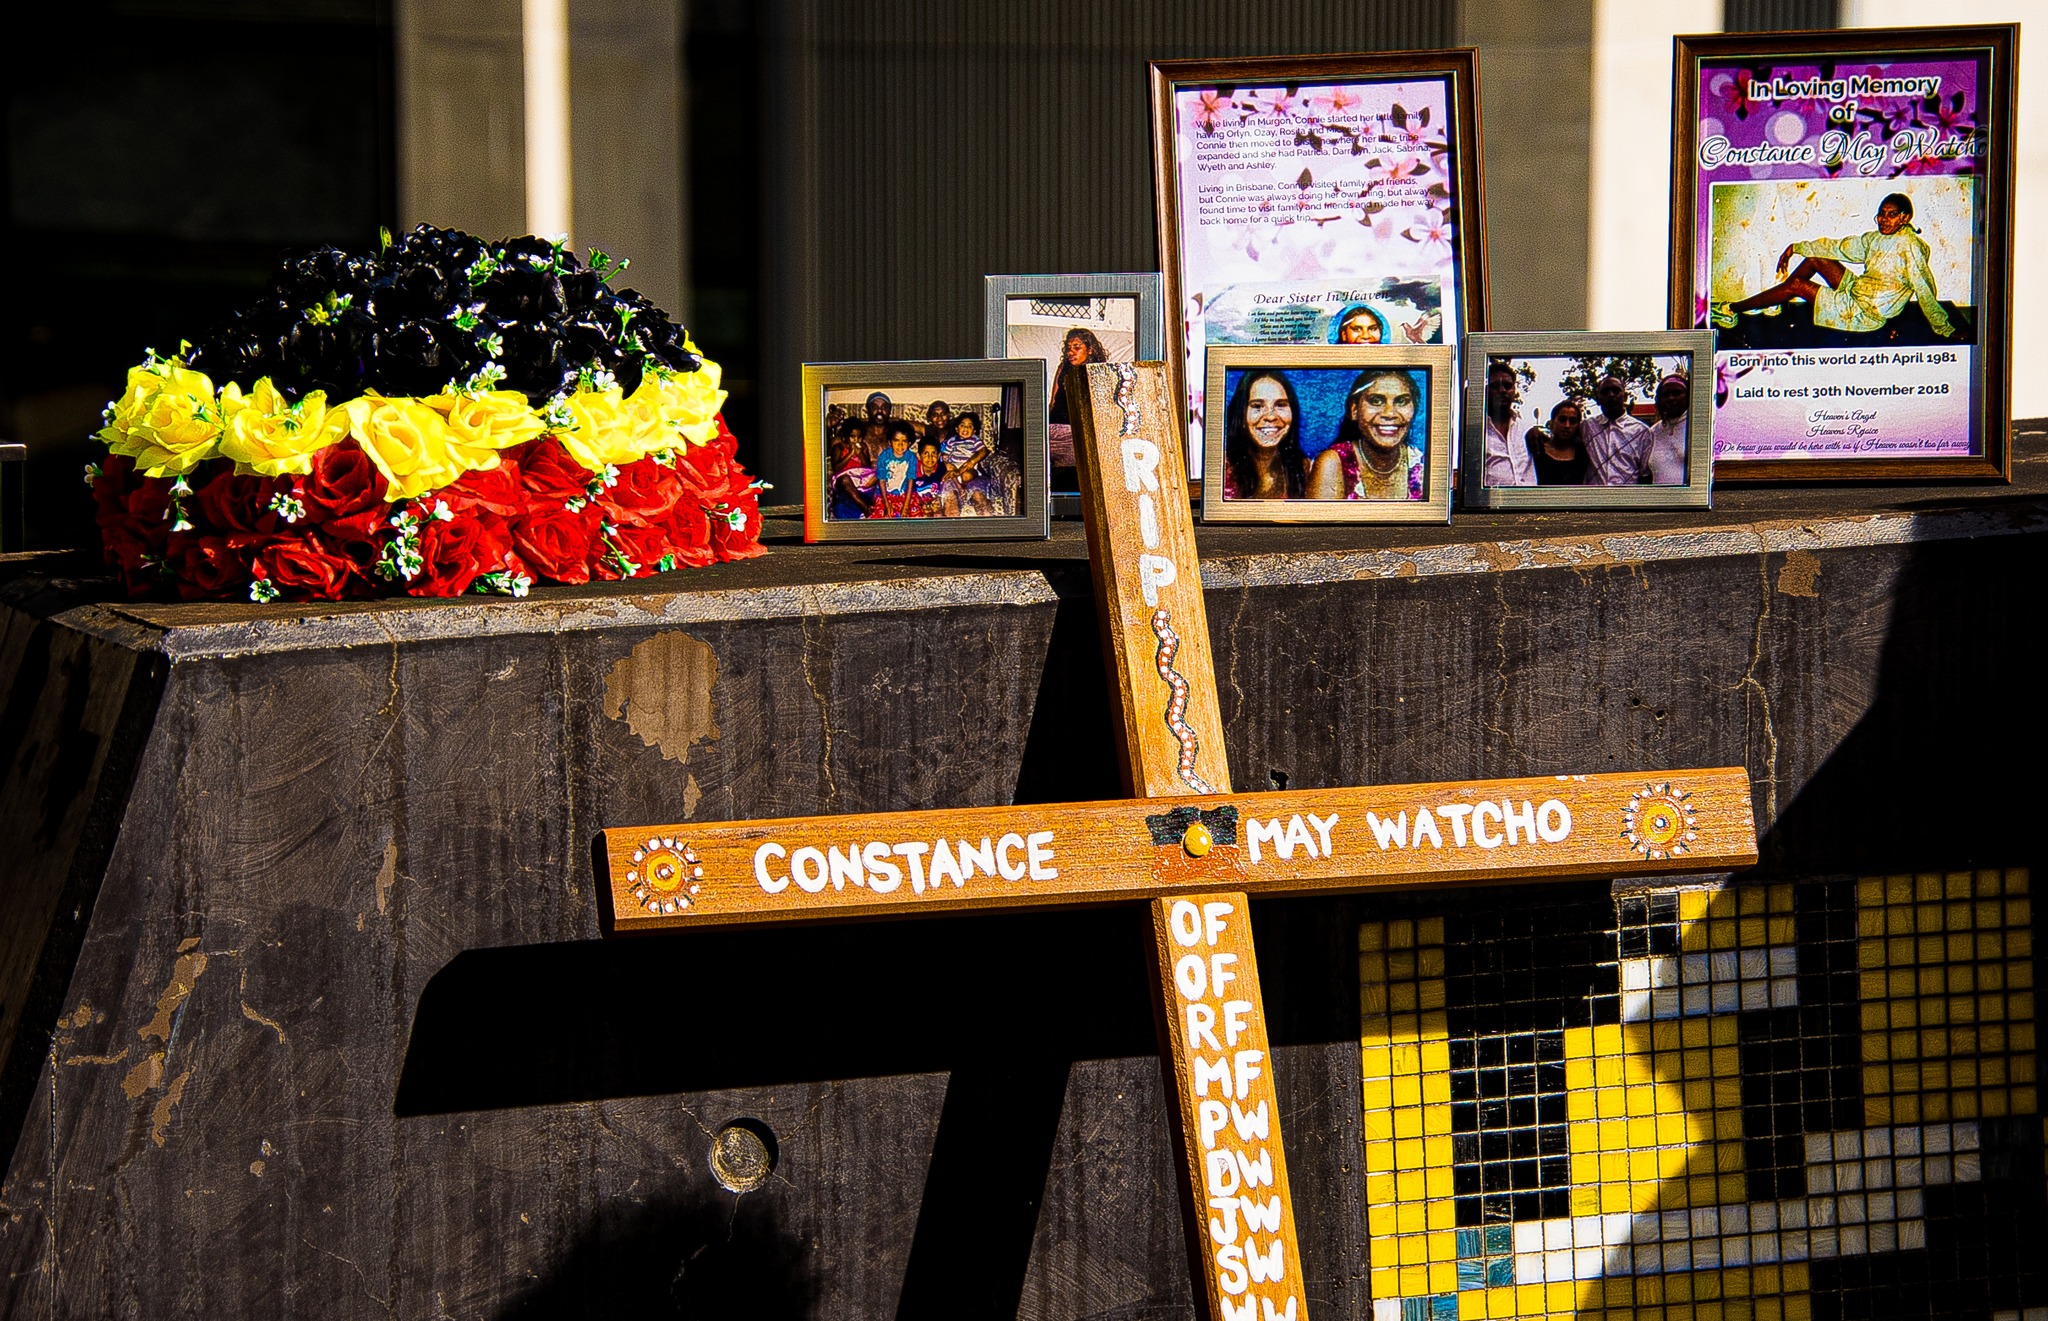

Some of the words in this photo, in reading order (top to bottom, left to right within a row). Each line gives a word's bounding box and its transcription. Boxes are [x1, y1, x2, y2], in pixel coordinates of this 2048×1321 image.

[1751, 80, 1768, 98] In
[1776, 79, 1844, 98] Loving
[1851, 76, 1938, 97] Memory
[1832, 103, 1854, 121] of
[1222, 118, 1246, 128] living
[1248, 118, 1256, 126] in
[1295, 115, 1326, 124] Connie
[1327, 113, 1358, 122] started
[1360, 113, 1374, 122] her
[1196, 131, 1225, 140] having
[1280, 127, 1306, 136] Rosita
[1307, 126, 1325, 135] and
[1196, 141, 1227, 150] Connie
[1229, 139, 1249, 148] then
[1250, 138, 1281, 148] moved
[1282, 139, 1292, 147] to
[1362, 135, 1376, 144] her
[1399, 132, 1419, 142] tribe
[1197, 151, 1240, 161] expanded
[1242, 150, 1259, 159] and
[1260, 149, 1277, 158] she
[1278, 149, 1295, 157] had
[1700, 136, 1813, 167] Constance
[1821, 131, 1886, 174] May
[1197, 163, 1226, 173] Wyeth
[1228, 162, 1245, 170] and
[1198, 185, 1224, 194] Living
[1226, 184, 1234, 192] in
[1277, 180, 1308, 190] Connie
[1309, 180, 1338, 189] visited
[1339, 178, 1366, 188] family
[1367, 178, 1384, 187] and
[1199, 195, 1214, 204] but
[1215, 195, 1246, 203] Connie
[1266, 193, 1297, 203] always
[1298, 192, 1323, 201] doing
[1325, 191, 1339, 199] her
[1340, 191, 1360, 199] own
[1387, 188, 1403, 197] but
[1199, 206, 1225, 214] found
[1226, 205, 1246, 214] time
[1248, 205, 1257, 213] to
[1258, 204, 1275, 212] visit
[1277, 203, 1303, 213] family
[1304, 201, 1322, 210] and
[1324, 200, 1355, 210] friends
[1355, 200, 1372, 209] and
[1401, 198, 1415, 207] her
[1417, 199, 1435, 208] way
[1200, 216, 1221, 225] back
[1223, 215, 1248, 224] home
[1250, 215, 1262, 224] for
[1271, 214, 1294, 225] quick
[1253, 293, 1285, 304] Dear
[1286, 291, 1322, 304] Sister
[1326, 291, 1340, 302] In
[1341, 289, 1390, 302] Heaven
[1729, 355, 1761, 367] Born
[1763, 354, 1789, 367] into
[1791, 353, 1816, 366] this
[1818, 353, 1856, 365] world
[1859, 352, 1889, 367] 24th
[1891, 352, 1924, 367] April
[1926, 352, 1958, 365] 1981
[1736, 386, 1764, 399] Laid
[1767, 387, 1781, 398] to
[1784, 387, 1809, 398] rest
[1812, 385, 1842, 400] 30th
[1845, 384, 1915, 397] November
[1917, 383, 1950, 396] 2018
[1808, 410, 1850, 423] Heaven's
[1851, 409, 1877, 423] Angel
[1806, 425, 1845, 437] Heavens
[1847, 424, 1879, 438] Rejoice
[1714, 440, 1735, 453] We
[1736, 442, 1756, 451] know
[1756, 444, 1773, 454] you
[1774, 441, 1798, 451] would
[1799, 441, 1808, 451] be
[1808, 441, 1824, 451] here
[1825, 441, 1841, 450] with
[1853, 440, 1861, 453] if
[1861, 438, 1898, 451] Heaven
[1899, 438, 1923, 449] wasn't
[1924, 440, 1936, 448] too
[1936, 439, 1949, 452] far
[753, 831, 1059, 895] CONSTANCE
[1245, 812, 1339, 865] MAY
[1365, 798, 1572, 850] WATCHO
